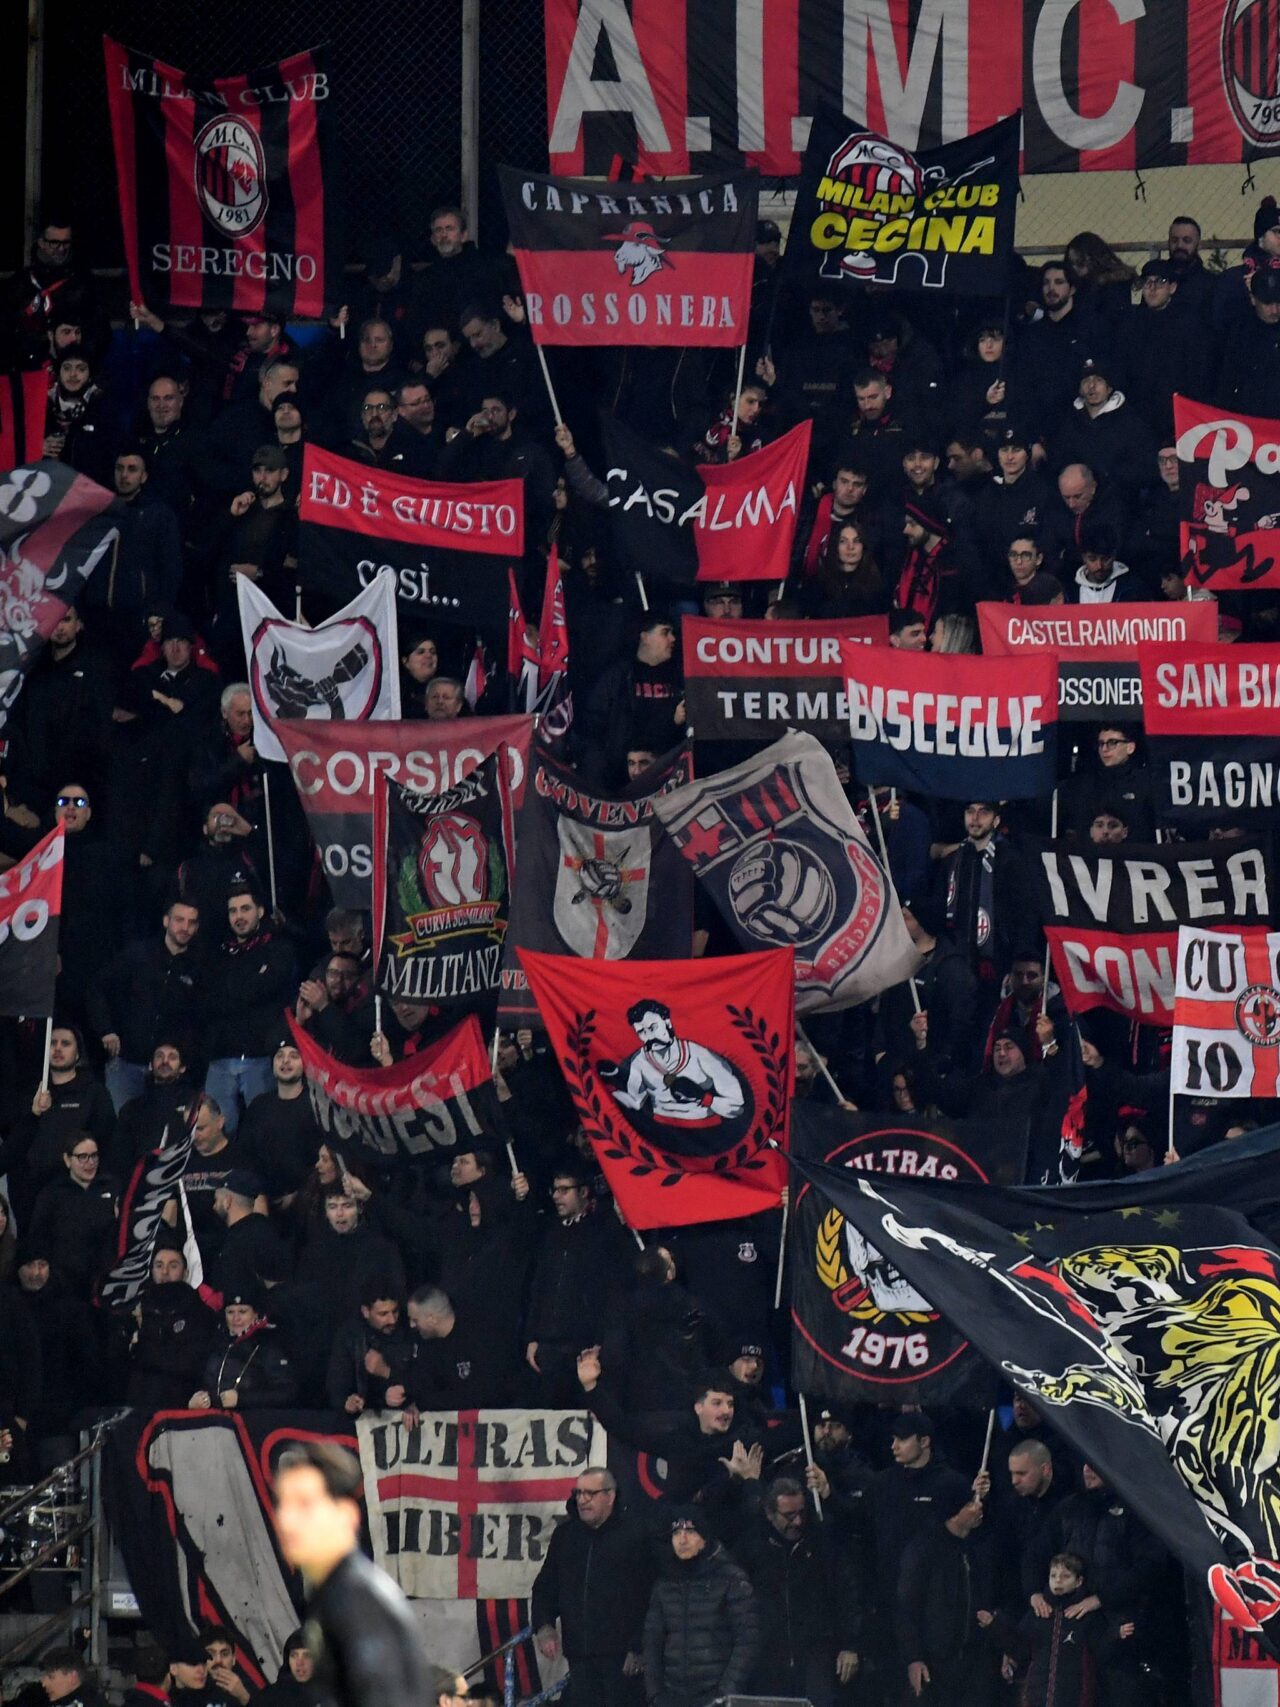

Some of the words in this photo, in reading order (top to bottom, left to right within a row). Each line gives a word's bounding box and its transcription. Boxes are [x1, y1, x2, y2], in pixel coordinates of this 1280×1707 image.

[120, 65, 229, 108] MILAN
[236, 72, 331, 105] CLUB
[216, 205, 252, 225] 1981
[521, 180, 739, 216] CAPRANICA
[816, 176, 915, 215] MILAN
[923, 184, 1000, 211] CLUB
[810, 214, 997, 256] CECINA
[151, 242, 317, 283] SEREGNO
[526, 291, 736, 328] ROSSONERA
[307, 470, 351, 509] ED
[361, 481, 381, 517] È
[392, 494, 518, 536] GIUSTO
[606, 467, 797, 532] CASALMA
[696, 635, 874, 665] CONTUR
[1006, 617, 1187, 646] CASTELRAIMONDO
[716, 689, 851, 722] TERME
[1057, 677, 1144, 706] OSSONER
[1155, 662, 1228, 710] SAN
[847, 676, 1046, 759] BISCEGLIE
[1040, 847, 1270, 924] IVREA
[415, 911, 453, 937] CURVA
[841, 1325, 930, 1369] 1976
[369, 1416, 590, 1471] ULTRAS
